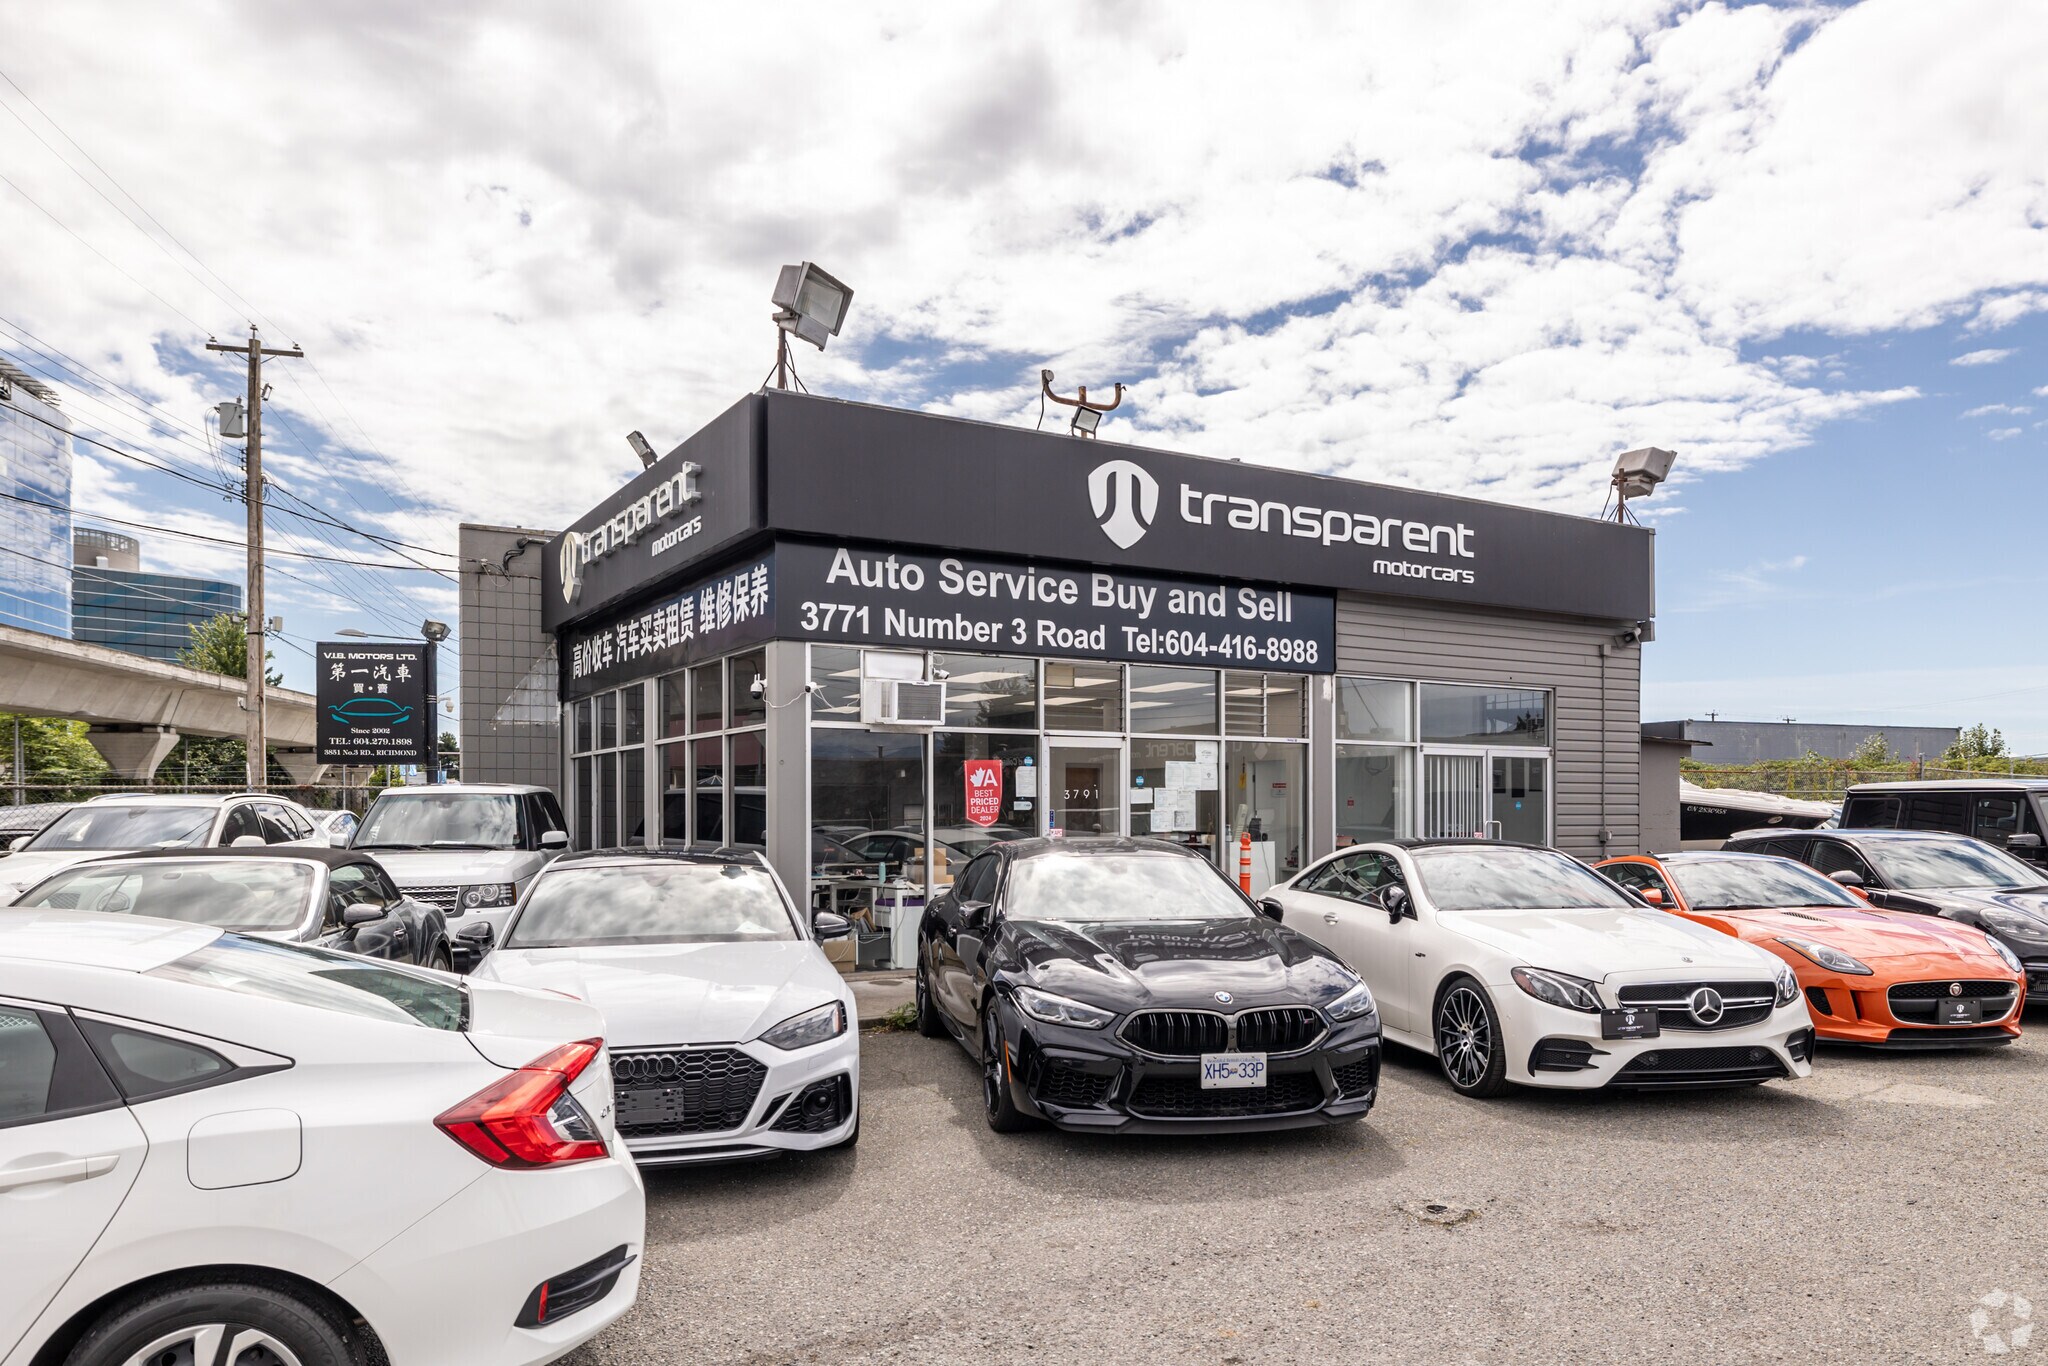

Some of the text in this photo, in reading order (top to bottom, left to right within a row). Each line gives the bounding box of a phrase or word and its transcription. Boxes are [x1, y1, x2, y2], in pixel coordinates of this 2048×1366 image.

[582, 461, 702, 565] transparent
[1181, 484, 1474, 558] transparent
[652, 515, 702, 557] motorcars
[826, 549, 1292, 622] Auto Service Buy and Sell
[1373, 560, 1474, 584] motorcars
[573, 564, 769, 680] 高价收车 汽车买卖租赁 维修保养
[801, 602, 1318, 664] 3771 Number 3 Road Tel:604-416-8988
[329, 737, 413, 746] TEL: 604.279.1898
[970, 797, 999, 806] PRICED
[974, 789, 993, 797] BEST
[1063, 789, 1099, 800] 3791
[971, 806, 999, 814] DEALER
